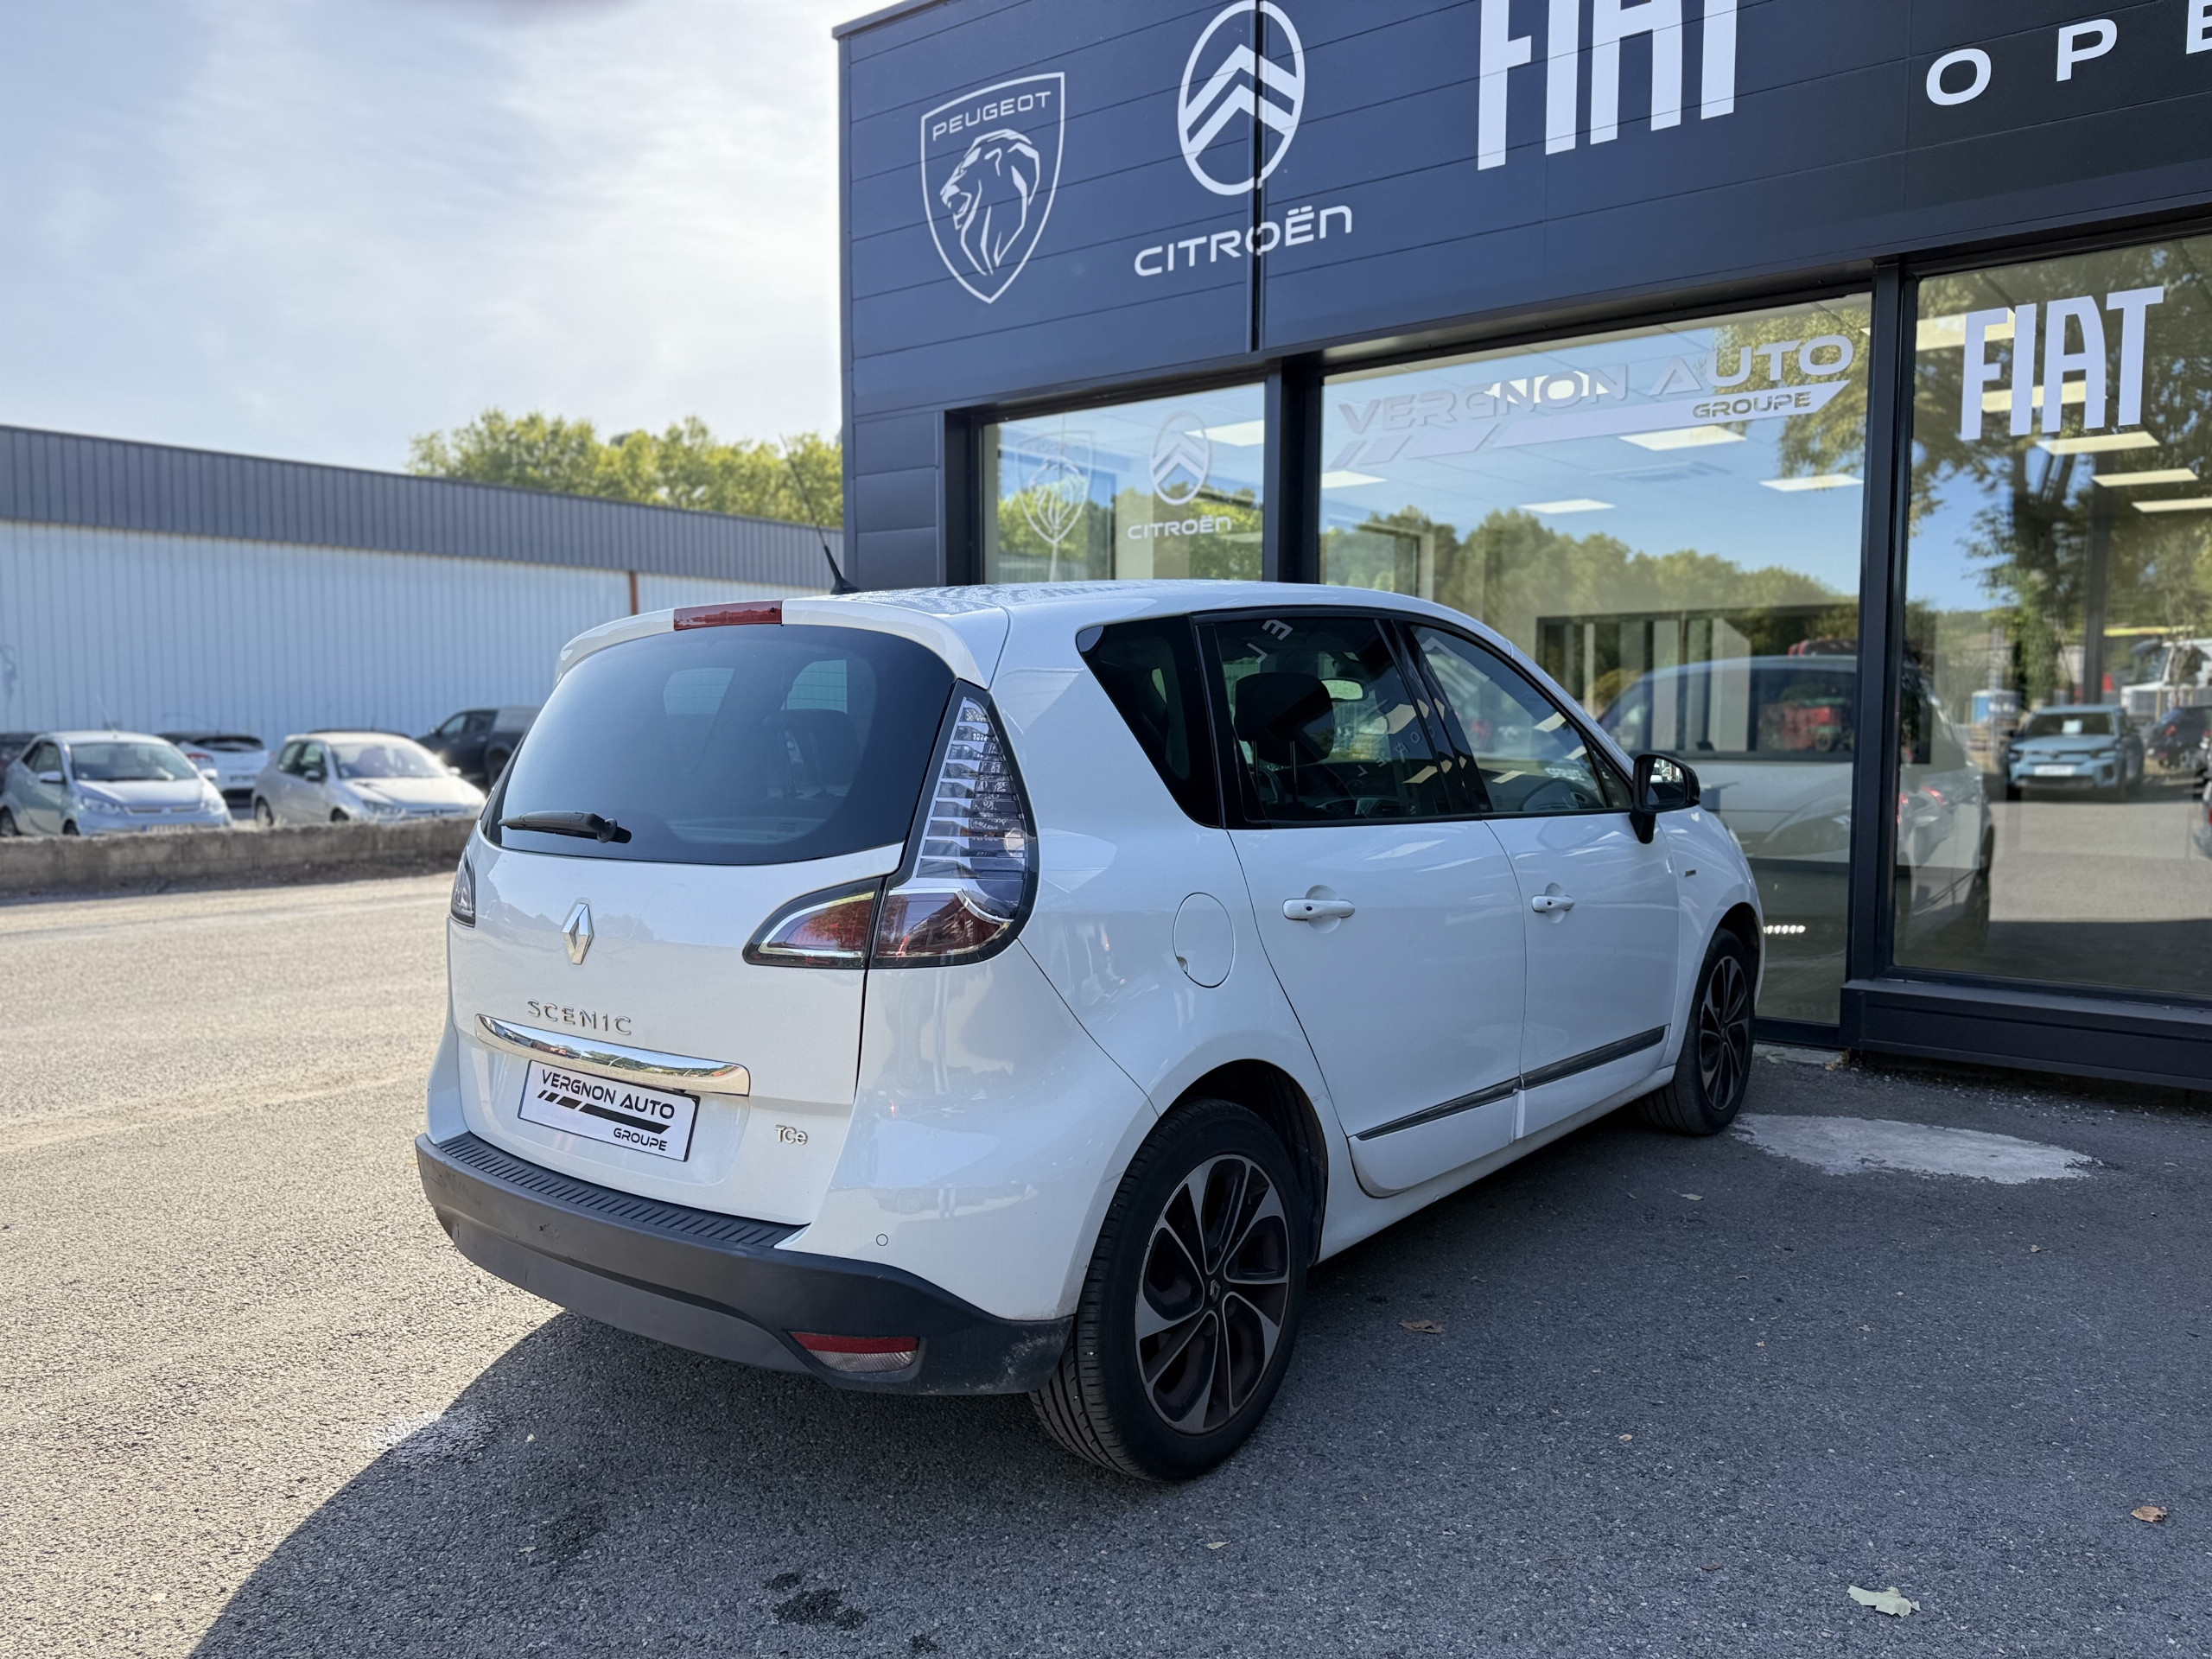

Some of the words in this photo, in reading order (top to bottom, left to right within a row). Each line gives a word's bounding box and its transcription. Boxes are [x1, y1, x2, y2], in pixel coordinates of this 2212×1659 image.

[933, 91, 1052, 142] PEUGEOT
[1134, 205, 1352, 276] CITROËN
[1338, 364, 1629, 435] VERGNON
[1648, 334, 1854, 397] AUTO
[1961, 286, 2164, 442] FIAT
[1692, 391, 1813, 419] GROUPE
[1127, 515, 1232, 540] CITROËN
[527, 999, 632, 1036] SCENIC
[542, 1069, 617, 1105] VERGNON
[619, 1093, 675, 1120] AUTO
[613, 1128, 668, 1152] GROUPE
[774, 1124, 808, 1146] TCe
